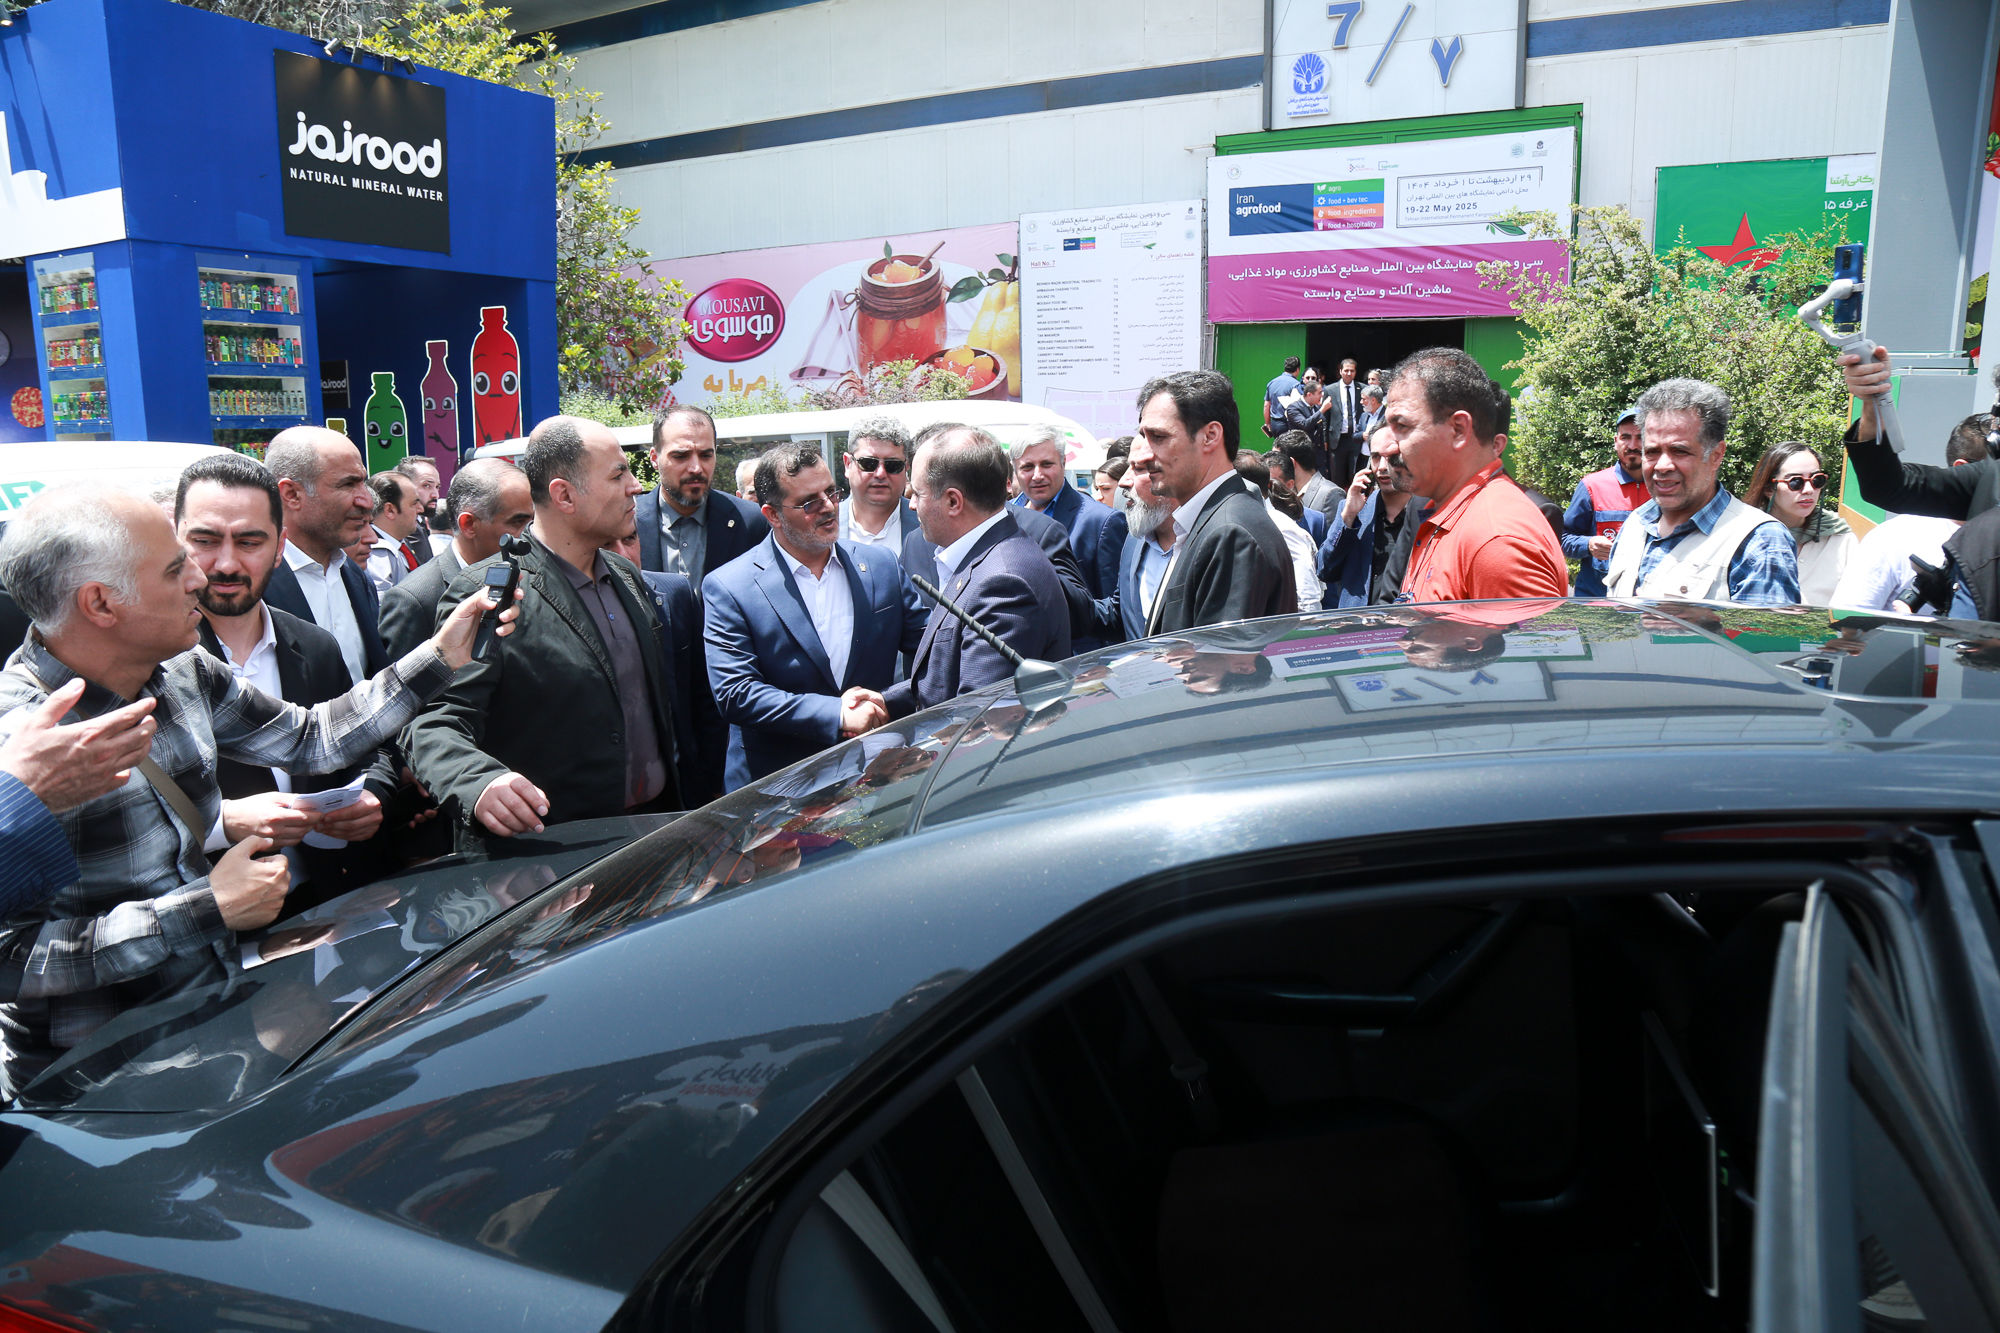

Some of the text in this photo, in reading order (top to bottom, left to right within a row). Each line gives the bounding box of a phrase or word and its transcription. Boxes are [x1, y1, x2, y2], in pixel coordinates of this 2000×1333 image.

[1327, 0, 1364, 49] 7
[288, 111, 442, 178] jajrood
[1434, 178, 1459, 188] خرداد
[1468, 177, 1476, 185] تا
[1476, 174, 1517, 185] اردیبهشت
[1521, 174, 1531, 182] ۲۹
[290, 168, 443, 202] NATURAL MINERAL WATER
[1236, 193, 1254, 204] Iran
[1347, 196, 1358, 204] bev
[1824, 197, 1868, 212] غرفه ۱۵
[1236, 202, 1282, 218] agrofood
[1343, 207, 1376, 216] ingredients
[1406, 202, 1478, 214] 19-22 May 2025
[1346, 220, 1376, 230] hospitality
[1372, 262, 1402, 274] المللی
[1406, 264, 1424, 274] بین
[1427, 258, 1473, 272] نمایشگاه
[1514, 261, 1520, 269] و
[1523, 259, 1544, 270] سی
[1228, 267, 1262, 281] غذایی،
[1264, 266, 1287, 279] مواد
[1289, 264, 1337, 278] کشاورزی،
[1338, 264, 1370, 278] صنایع
[1304, 283, 1452, 302] ماشین آلات و صنایع وابسته
[700, 296, 765, 316] MOUSAVI
[692, 314, 774, 343] موسوی
[321, 378, 346, 388] ajrood
